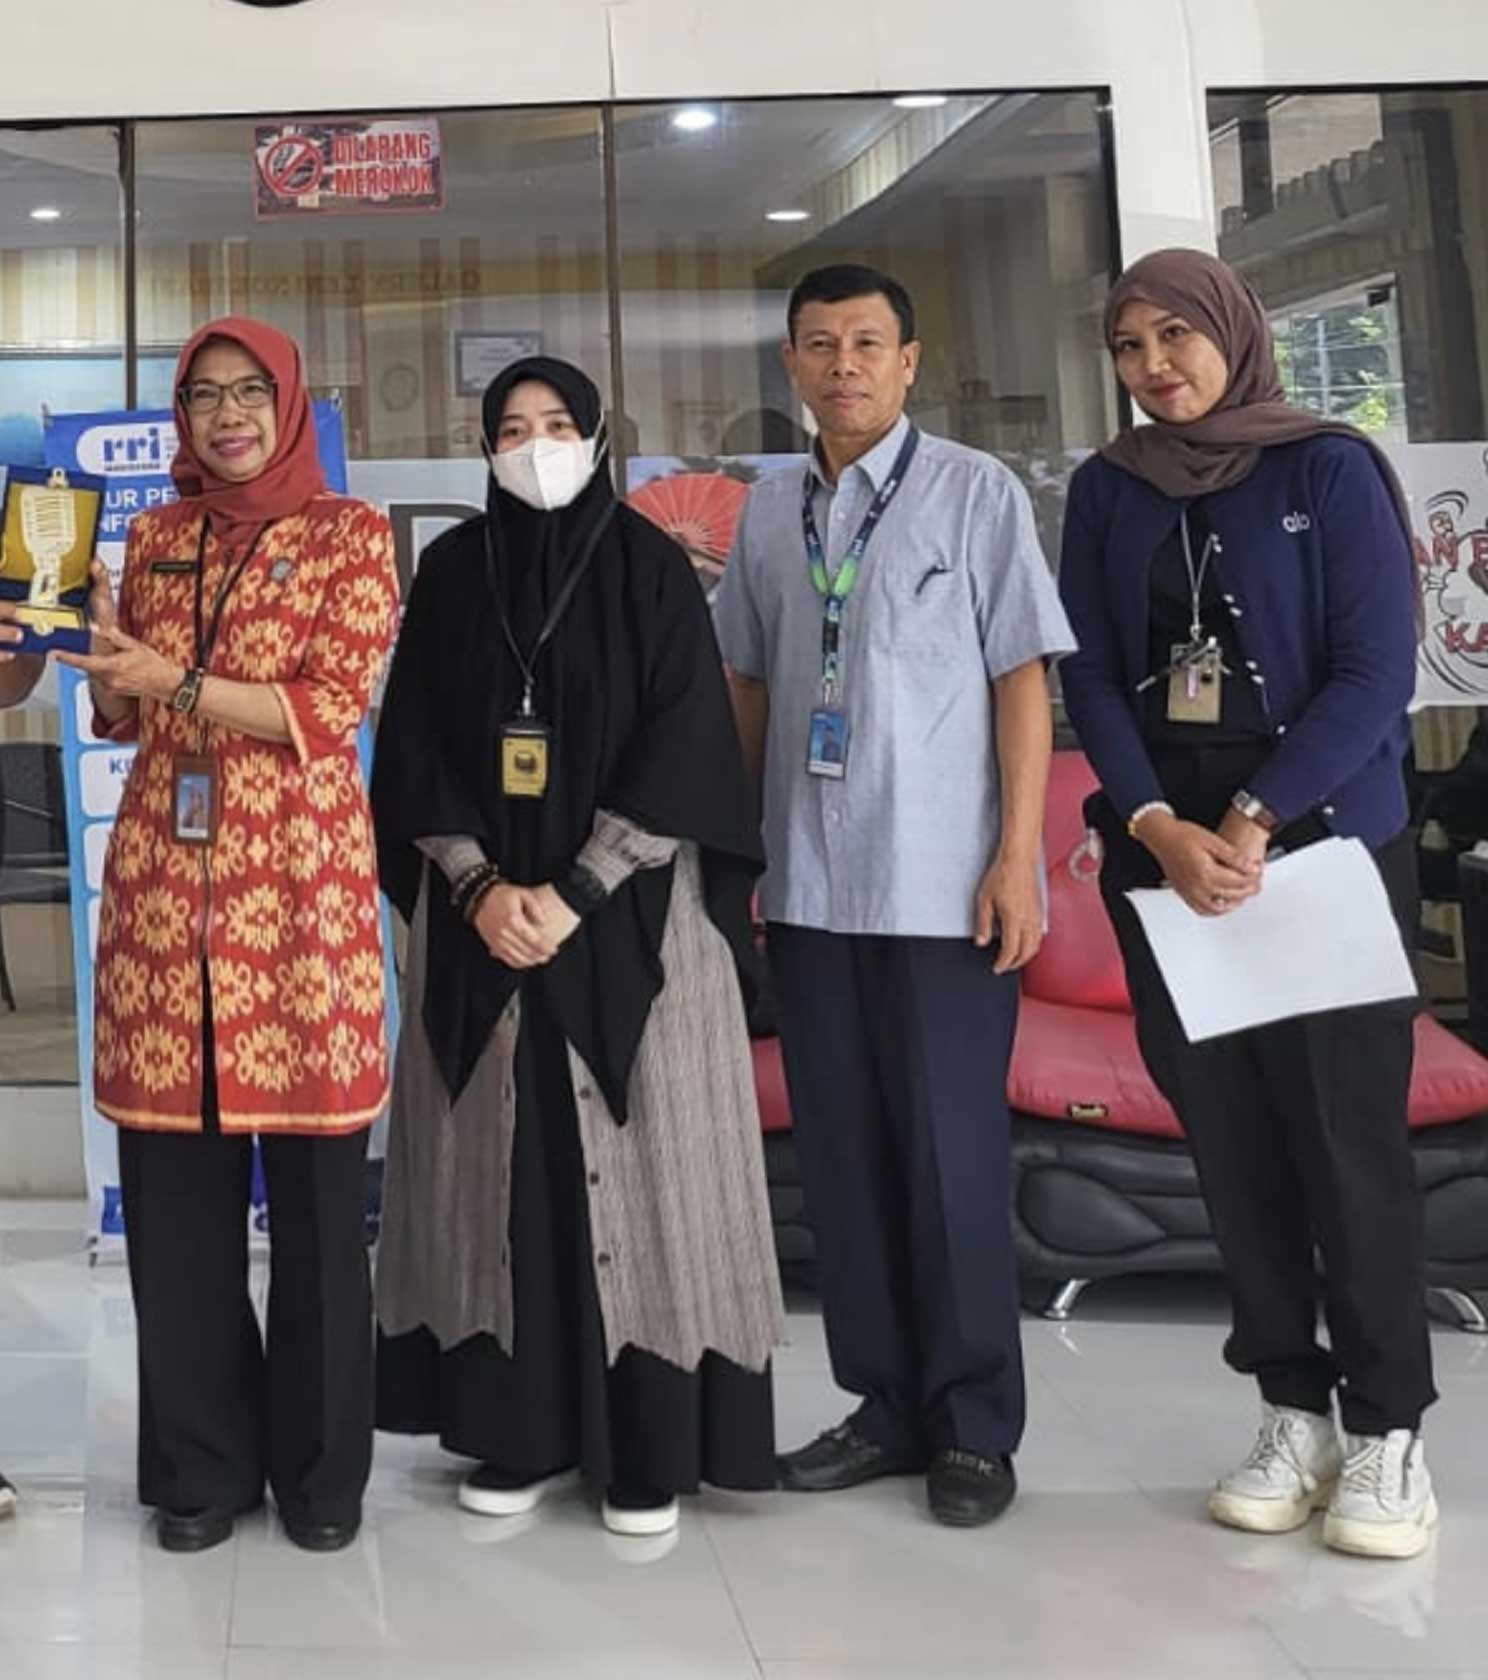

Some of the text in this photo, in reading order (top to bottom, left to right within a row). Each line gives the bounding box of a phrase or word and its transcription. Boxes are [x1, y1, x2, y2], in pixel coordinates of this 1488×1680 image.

[334, 131, 431, 163] DILARANG
[335, 166, 434, 195] MEROKOK
[103, 427, 160, 462] rri
